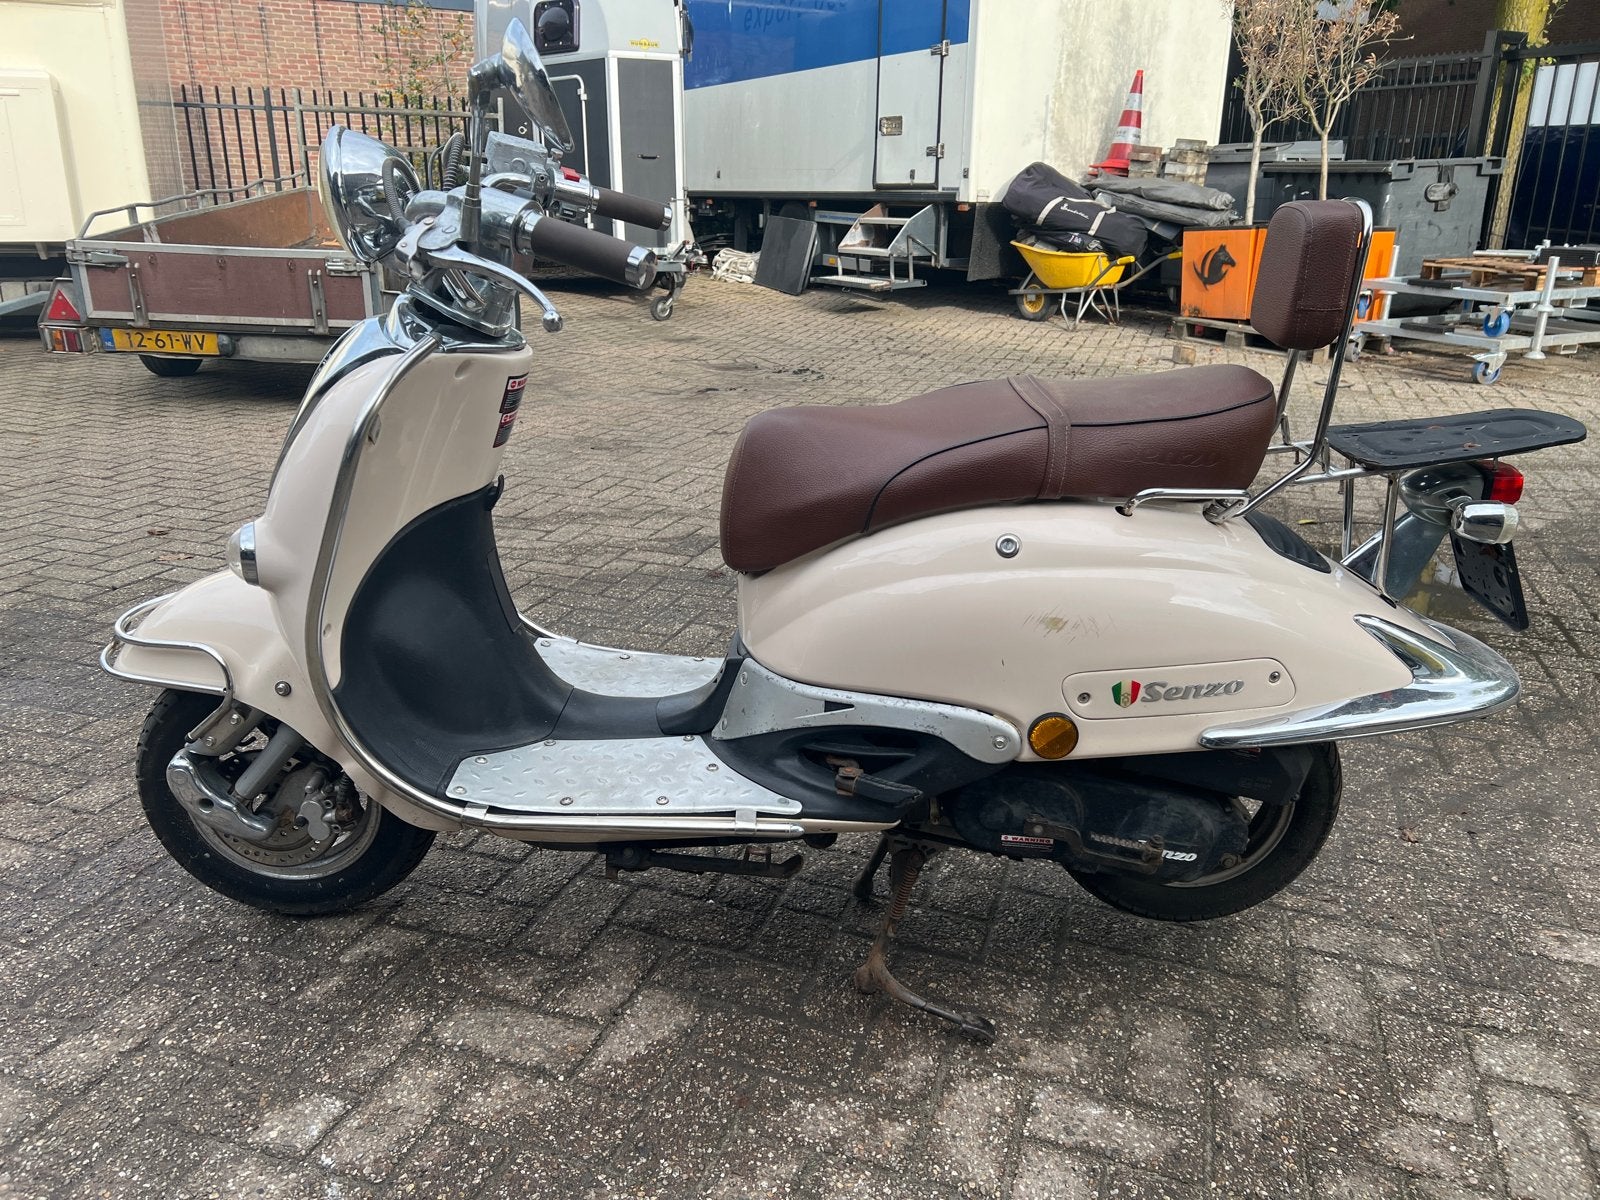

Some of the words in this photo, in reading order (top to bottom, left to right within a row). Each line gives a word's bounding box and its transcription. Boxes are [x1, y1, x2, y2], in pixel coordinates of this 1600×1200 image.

[126, 332, 205, 350] 12-61-WV
[1140, 679, 1245, 703] Senzo
[1011, 836, 1051, 844] WARNING
